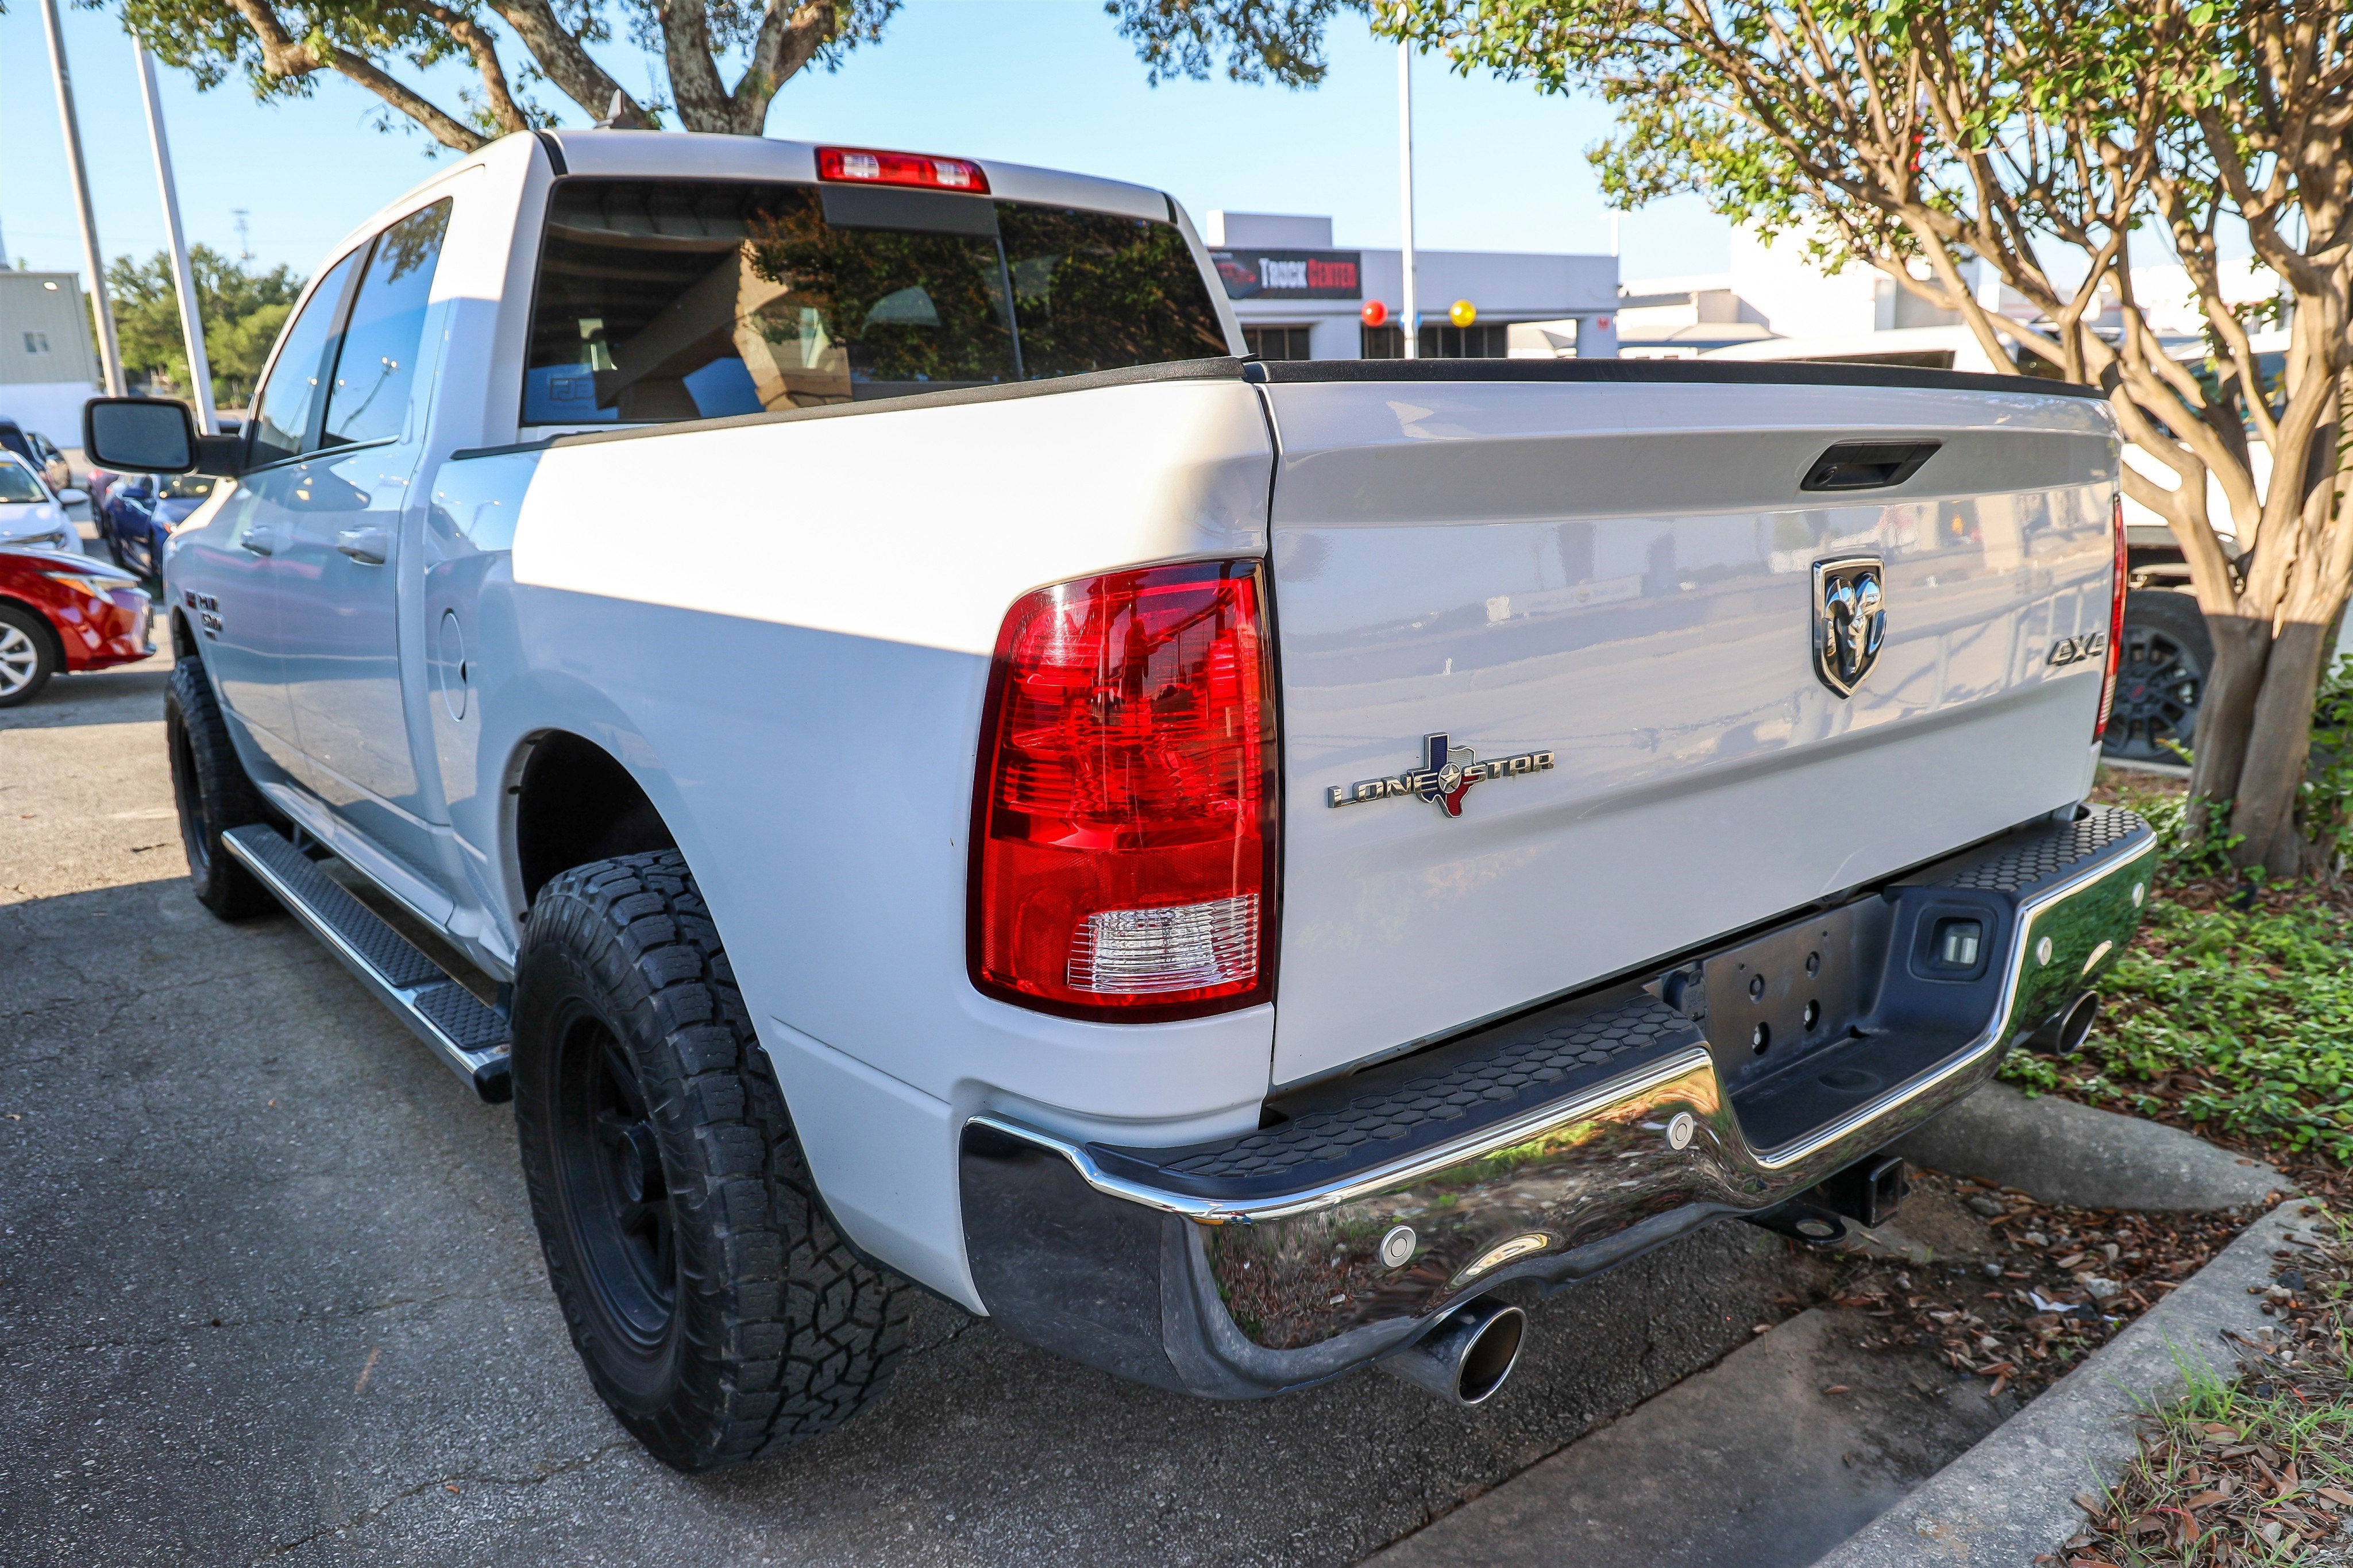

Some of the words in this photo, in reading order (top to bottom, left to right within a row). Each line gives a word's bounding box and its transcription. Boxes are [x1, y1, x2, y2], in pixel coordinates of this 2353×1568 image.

[1258, 257, 1307, 289] TRUCK
[1307, 258, 1357, 289] CENTER
[1327, 771, 1438, 809] LONE
[1463, 750, 1555, 785] STAR
